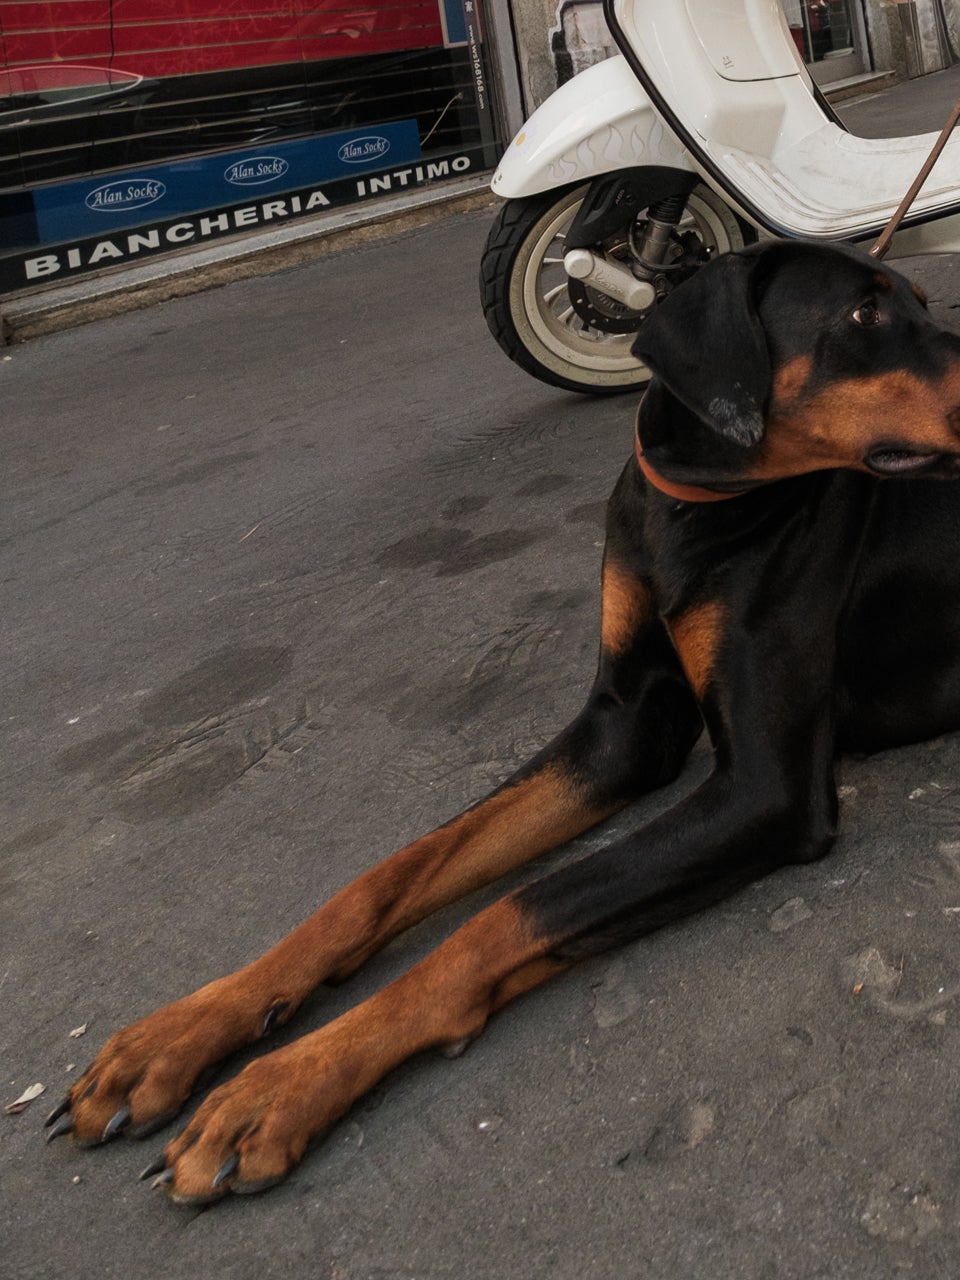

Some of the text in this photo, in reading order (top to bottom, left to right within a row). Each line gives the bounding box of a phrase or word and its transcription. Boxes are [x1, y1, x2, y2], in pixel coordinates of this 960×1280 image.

[341, 138, 386, 160] Alan Socks
[230, 159, 284, 181] Alan Socks
[91, 181, 159, 207] Alan Socks
[24, 156, 471, 280] BIANCHERIA INTIMO
